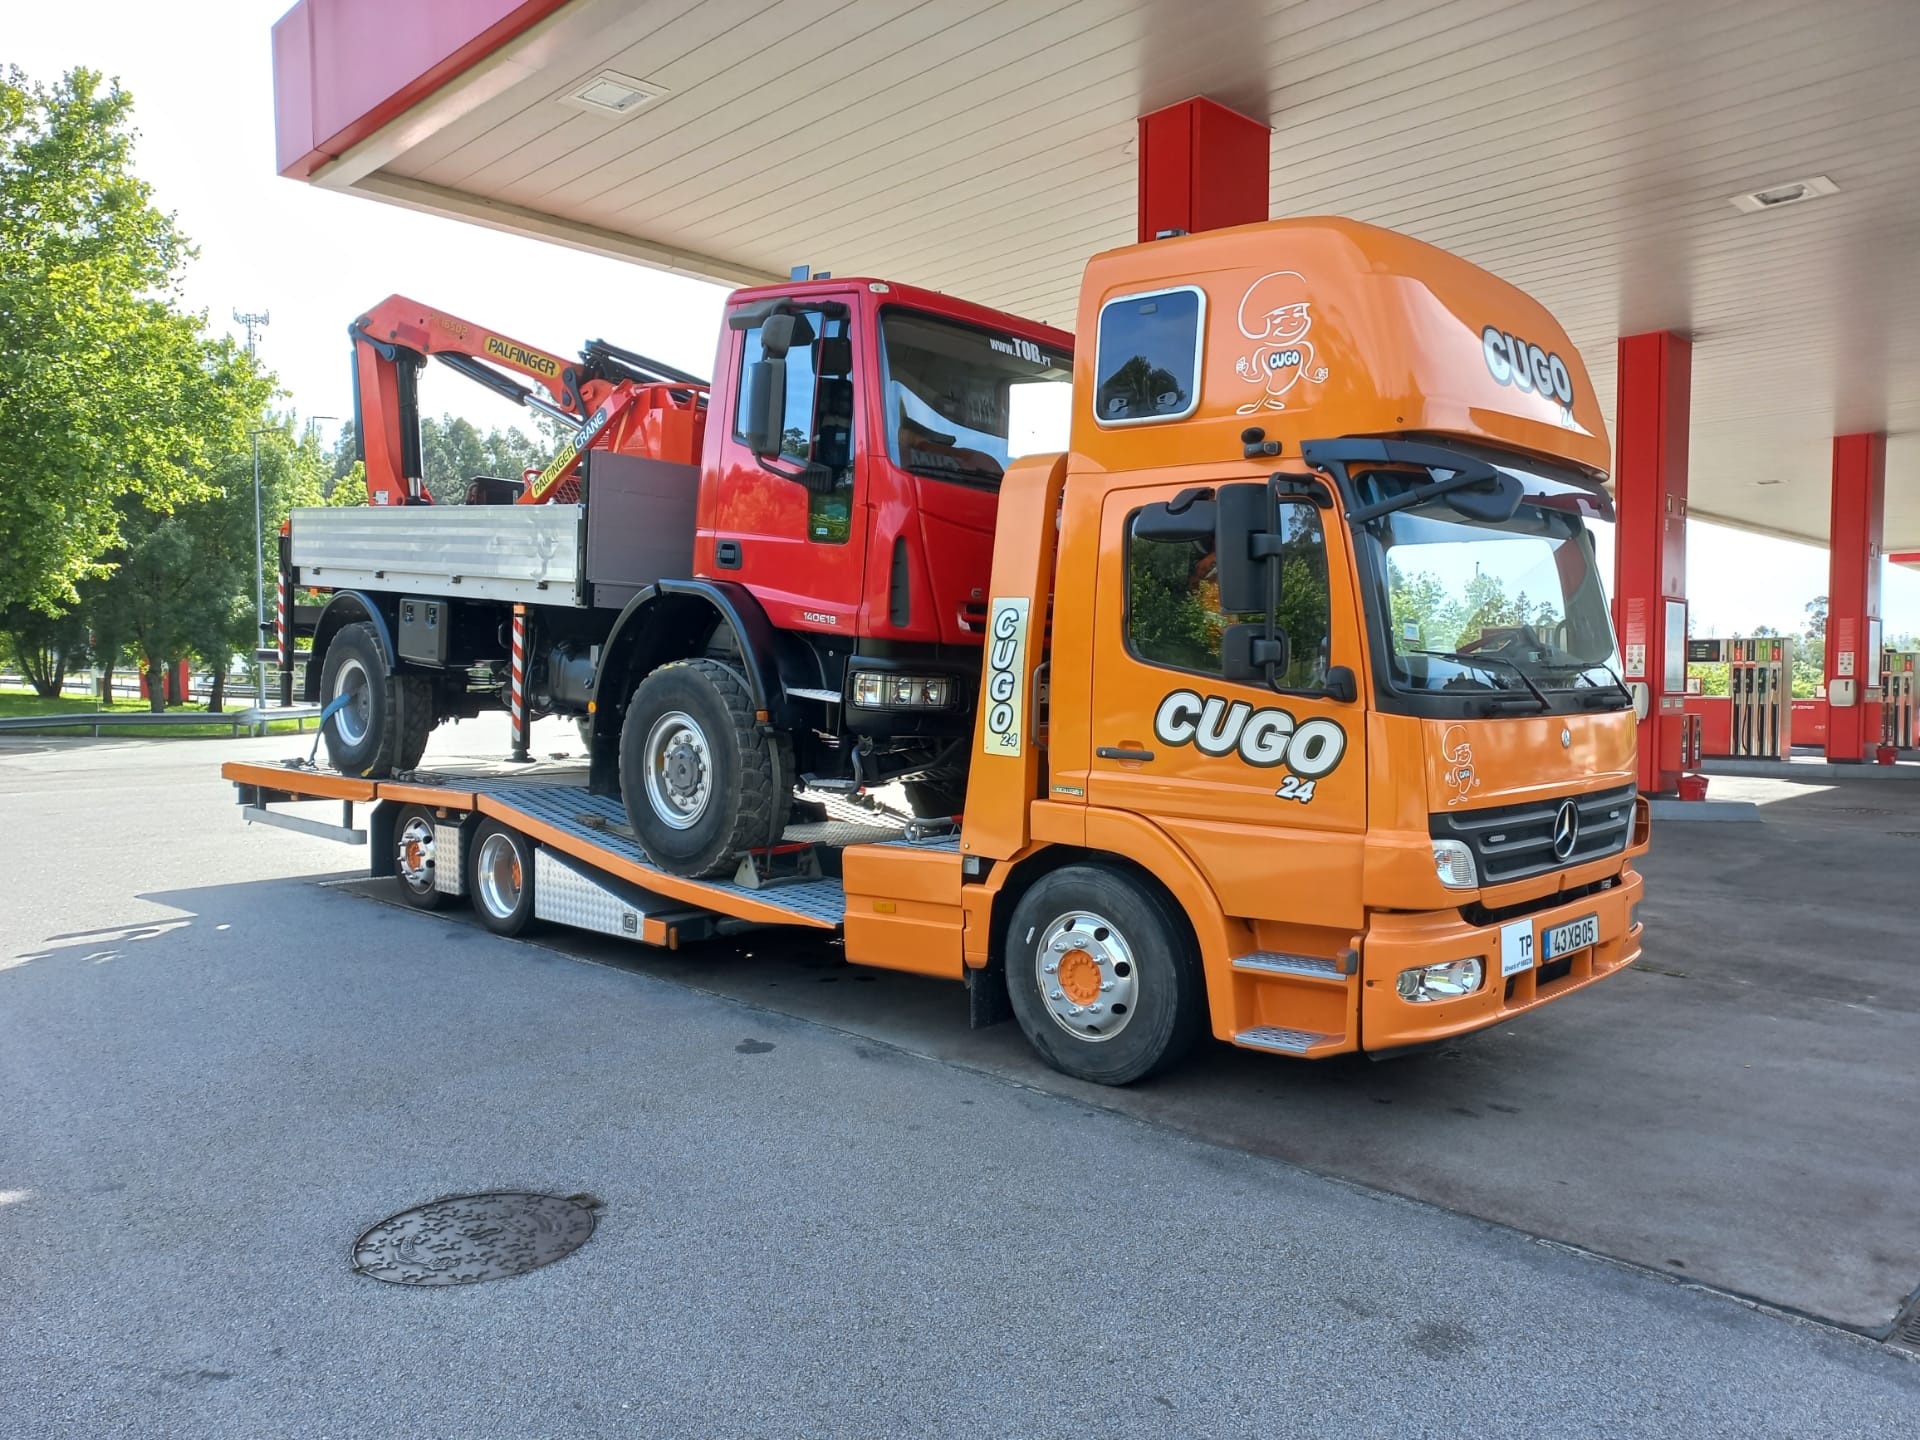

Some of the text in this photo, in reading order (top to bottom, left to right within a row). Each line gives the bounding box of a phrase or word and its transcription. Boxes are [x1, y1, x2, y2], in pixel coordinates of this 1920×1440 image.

[488, 338, 556, 376] PALFINGER
[1269, 350, 1301, 369] CUGO
[1482, 325, 1574, 407] CUGO
[574, 412, 604, 449] CRANE
[533, 445, 575, 495] PALFINGER
[803, 611, 837, 625] 140E18
[989, 607, 1020, 735] CUGO
[1000, 733, 1018, 747] 24
[1153, 689, 1348, 780] CUGO
[1275, 774, 1318, 804] 24
[1519, 934, 1532, 957] TP
